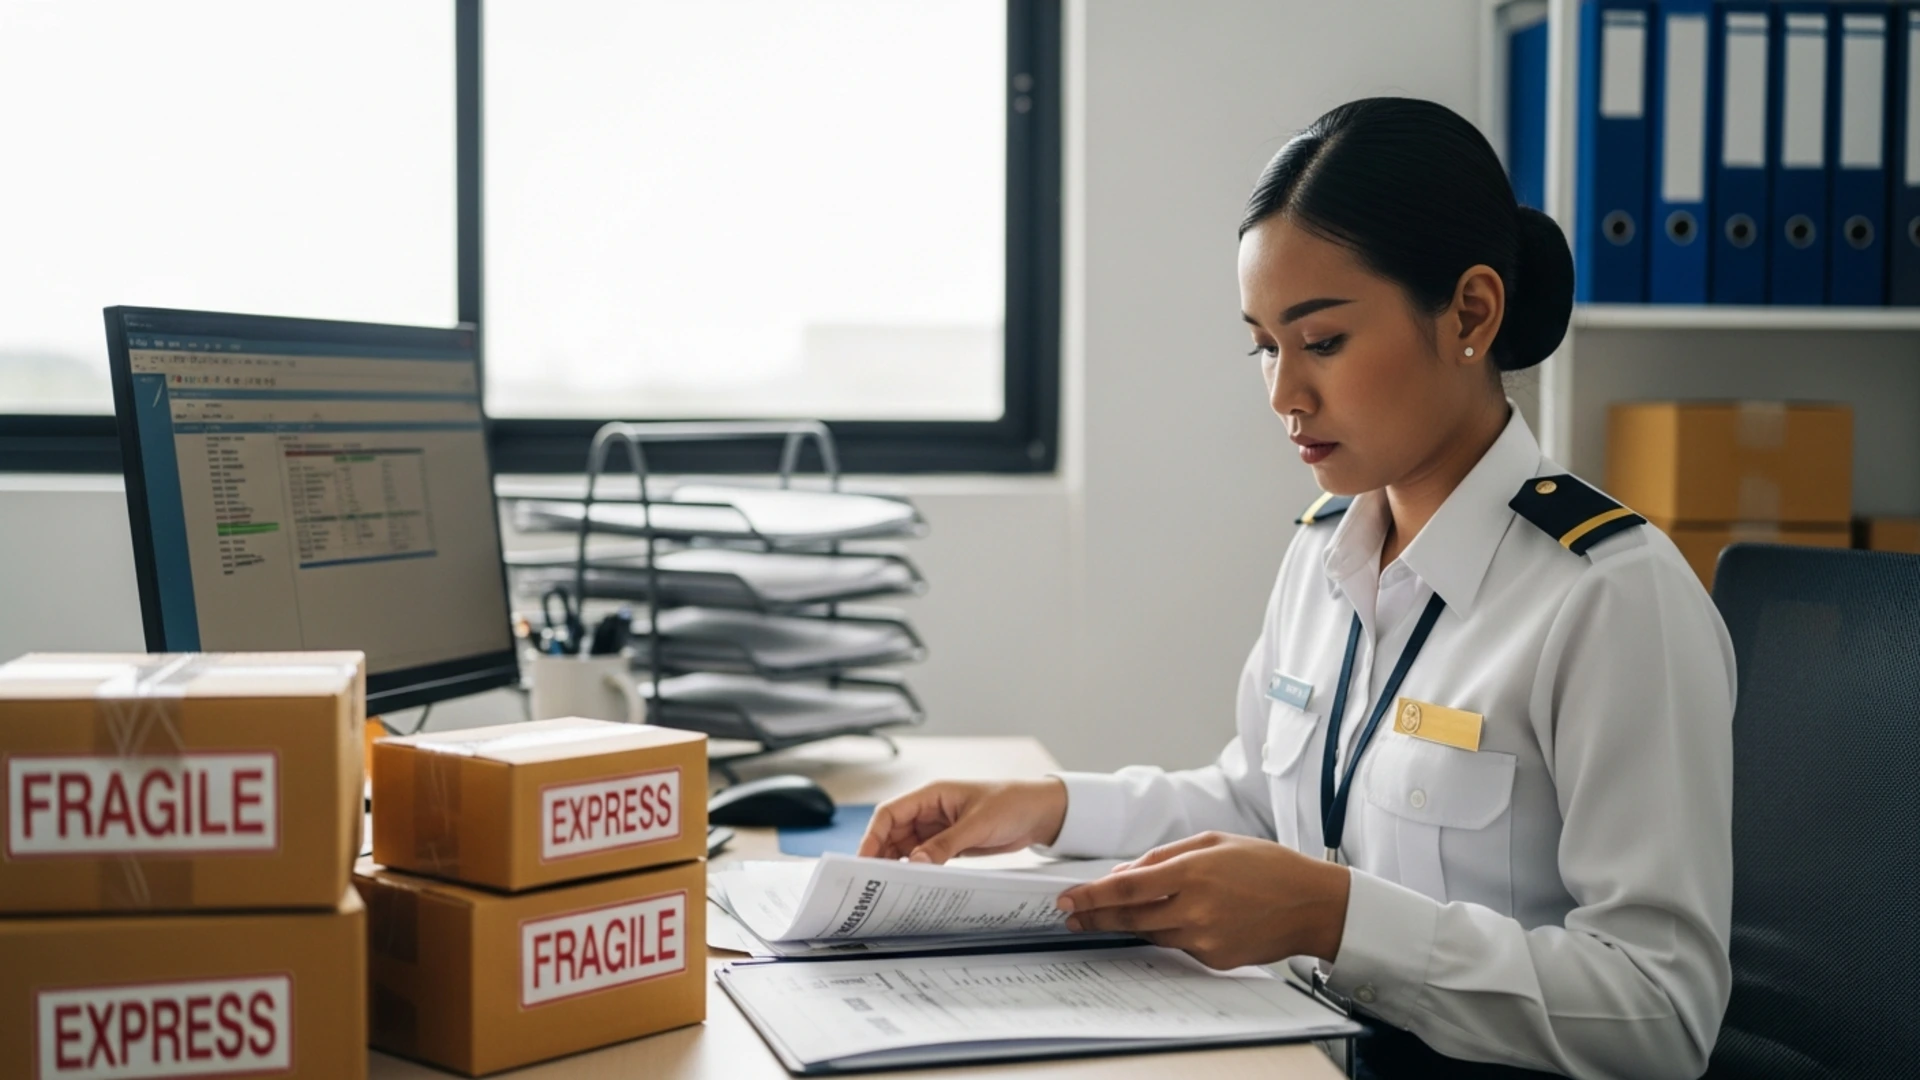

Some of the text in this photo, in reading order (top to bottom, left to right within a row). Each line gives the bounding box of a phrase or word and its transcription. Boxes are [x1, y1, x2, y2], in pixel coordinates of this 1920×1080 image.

[22, 769, 264, 839] FRAGILE
[552, 783, 672, 845] EXPRESS
[533, 909, 676, 989] FRAGILE
[55, 990, 276, 1070] EXPRESS
